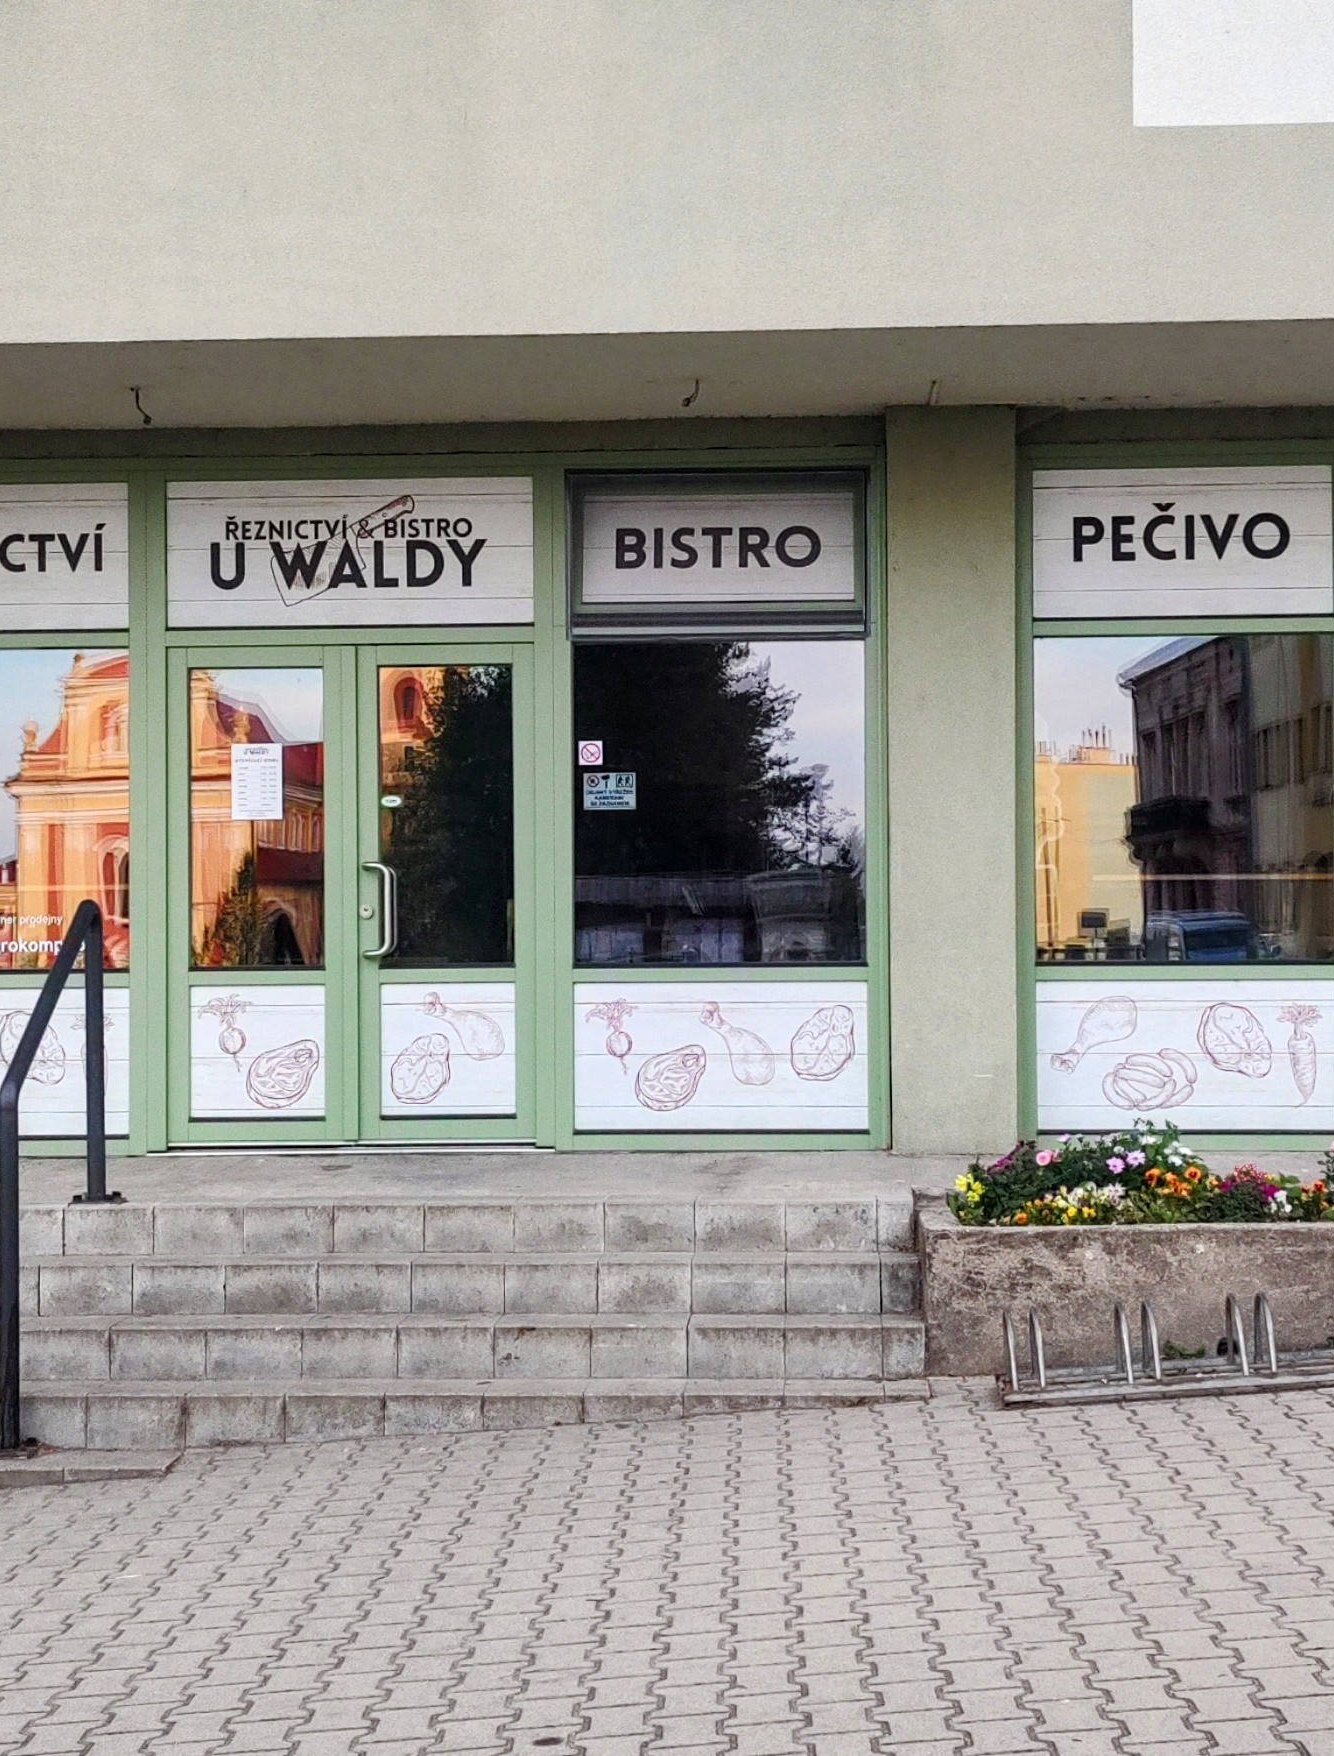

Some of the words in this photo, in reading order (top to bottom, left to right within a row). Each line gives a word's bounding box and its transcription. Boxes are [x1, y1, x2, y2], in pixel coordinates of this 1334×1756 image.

[225, 514, 349, 540] ŘEZNICTVÍ
[358, 519, 375, 539] &
[384, 517, 473, 538] BISTRO
[615, 525, 822, 569] BISTRO
[1073, 502, 1291, 562] PEČIVO
[210, 541, 245, 590] U
[269, 538, 487, 591] WALDY
